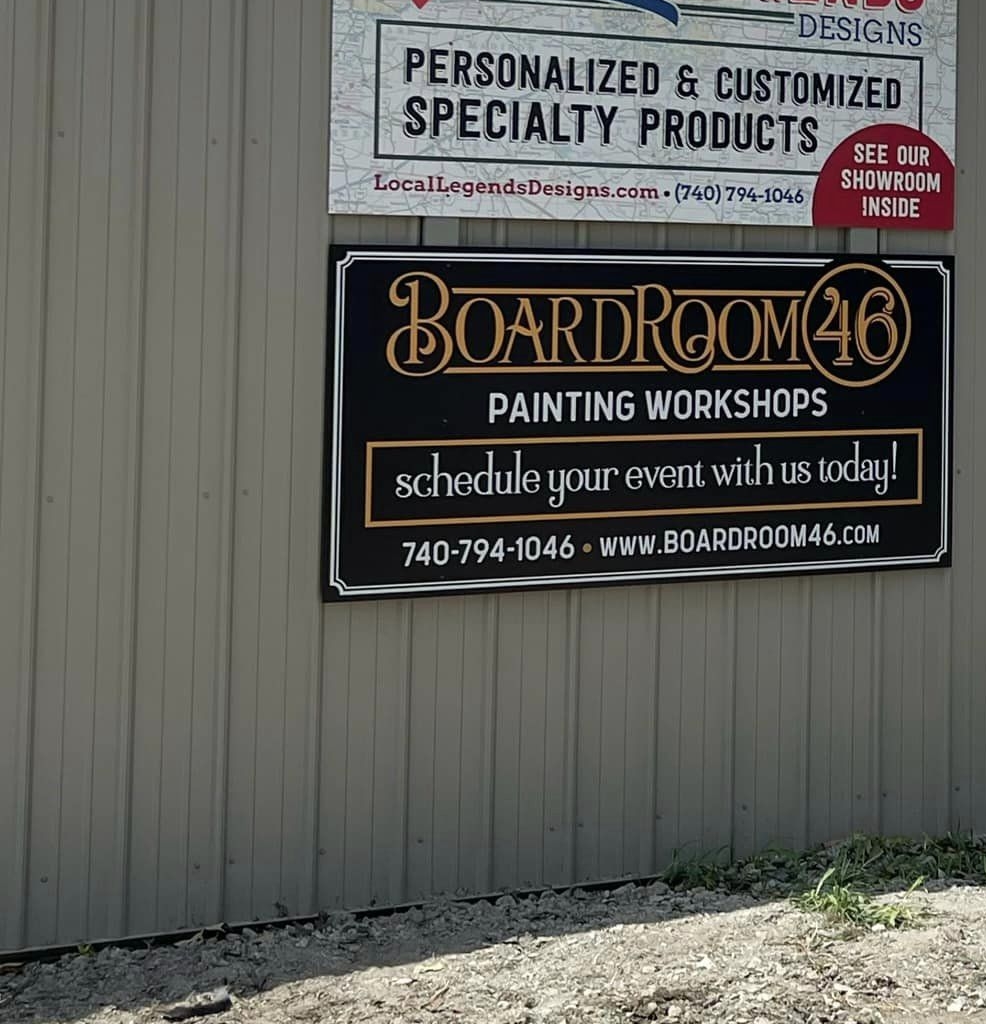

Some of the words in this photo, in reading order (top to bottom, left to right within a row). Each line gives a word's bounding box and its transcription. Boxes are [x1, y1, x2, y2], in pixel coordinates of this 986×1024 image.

[799, 13, 923, 47] DESIGNS
[403, 47, 660, 97] PERSONALIZED
[675, 64, 699, 100] &
[714, 66, 901, 111] CUSTOMIZED
[403, 95, 619, 147] SPECIALTY
[639, 107, 819, 156] PRODUCTS
[853, 143, 889, 164] SEE
[897, 145, 930, 167] OUR
[374, 174, 659, 201] LocalLegendsDesigns.com
[675, 183, 721, 204] (740)
[726, 186, 804, 204] 794-1046
[841, 169, 941, 193] SHOWROOM
[862, 196, 921, 218] INSIDE
[488, 390, 636, 424] PAINTING
[644, 387, 829, 420] WORKSHOPS
[395, 449, 541, 499] schedule
[547, 467, 619, 508] your
[625, 460, 706, 490] event
[711, 443, 775, 487] with
[781, 460, 812, 484] us
[818, 440, 898, 496] today!
[402, 534, 577, 568] 740-794-1046
